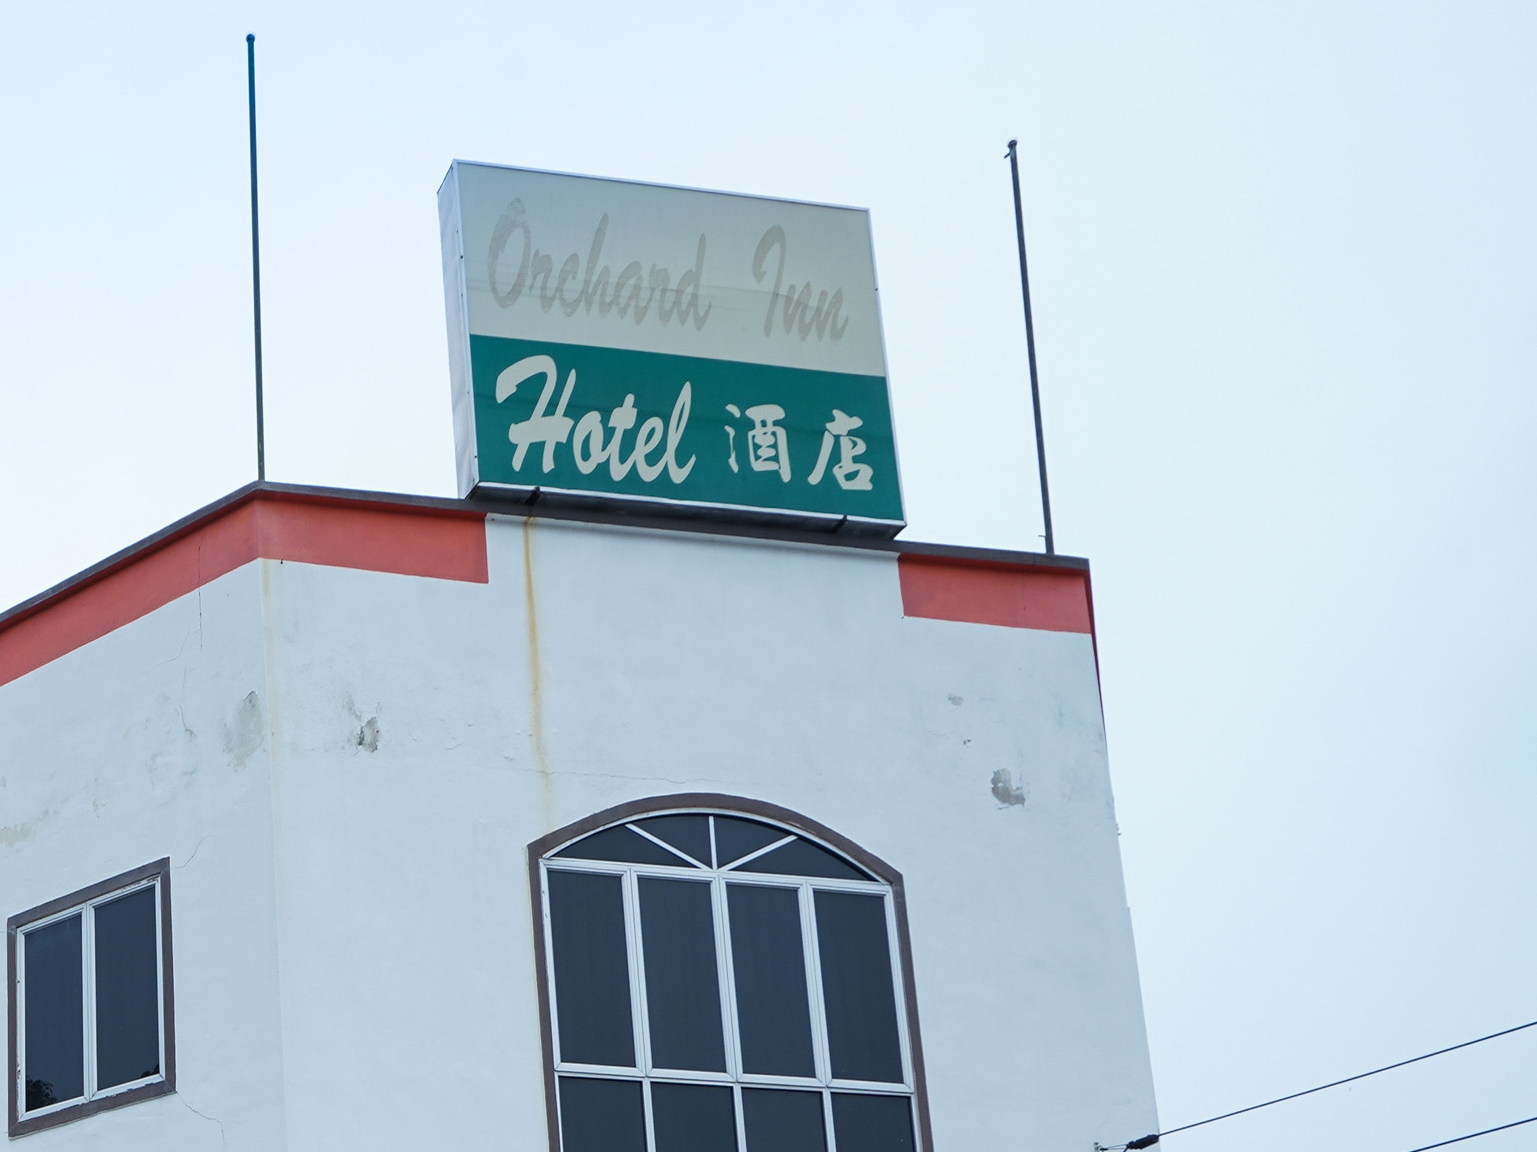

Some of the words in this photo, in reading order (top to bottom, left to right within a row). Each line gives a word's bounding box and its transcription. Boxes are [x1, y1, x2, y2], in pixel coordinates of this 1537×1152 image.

[487, 197, 712, 332] Orchard
[752, 224, 850, 343] Inn
[495, 354, 696, 485] Hotel
[724, 403, 874, 491] 酒店
